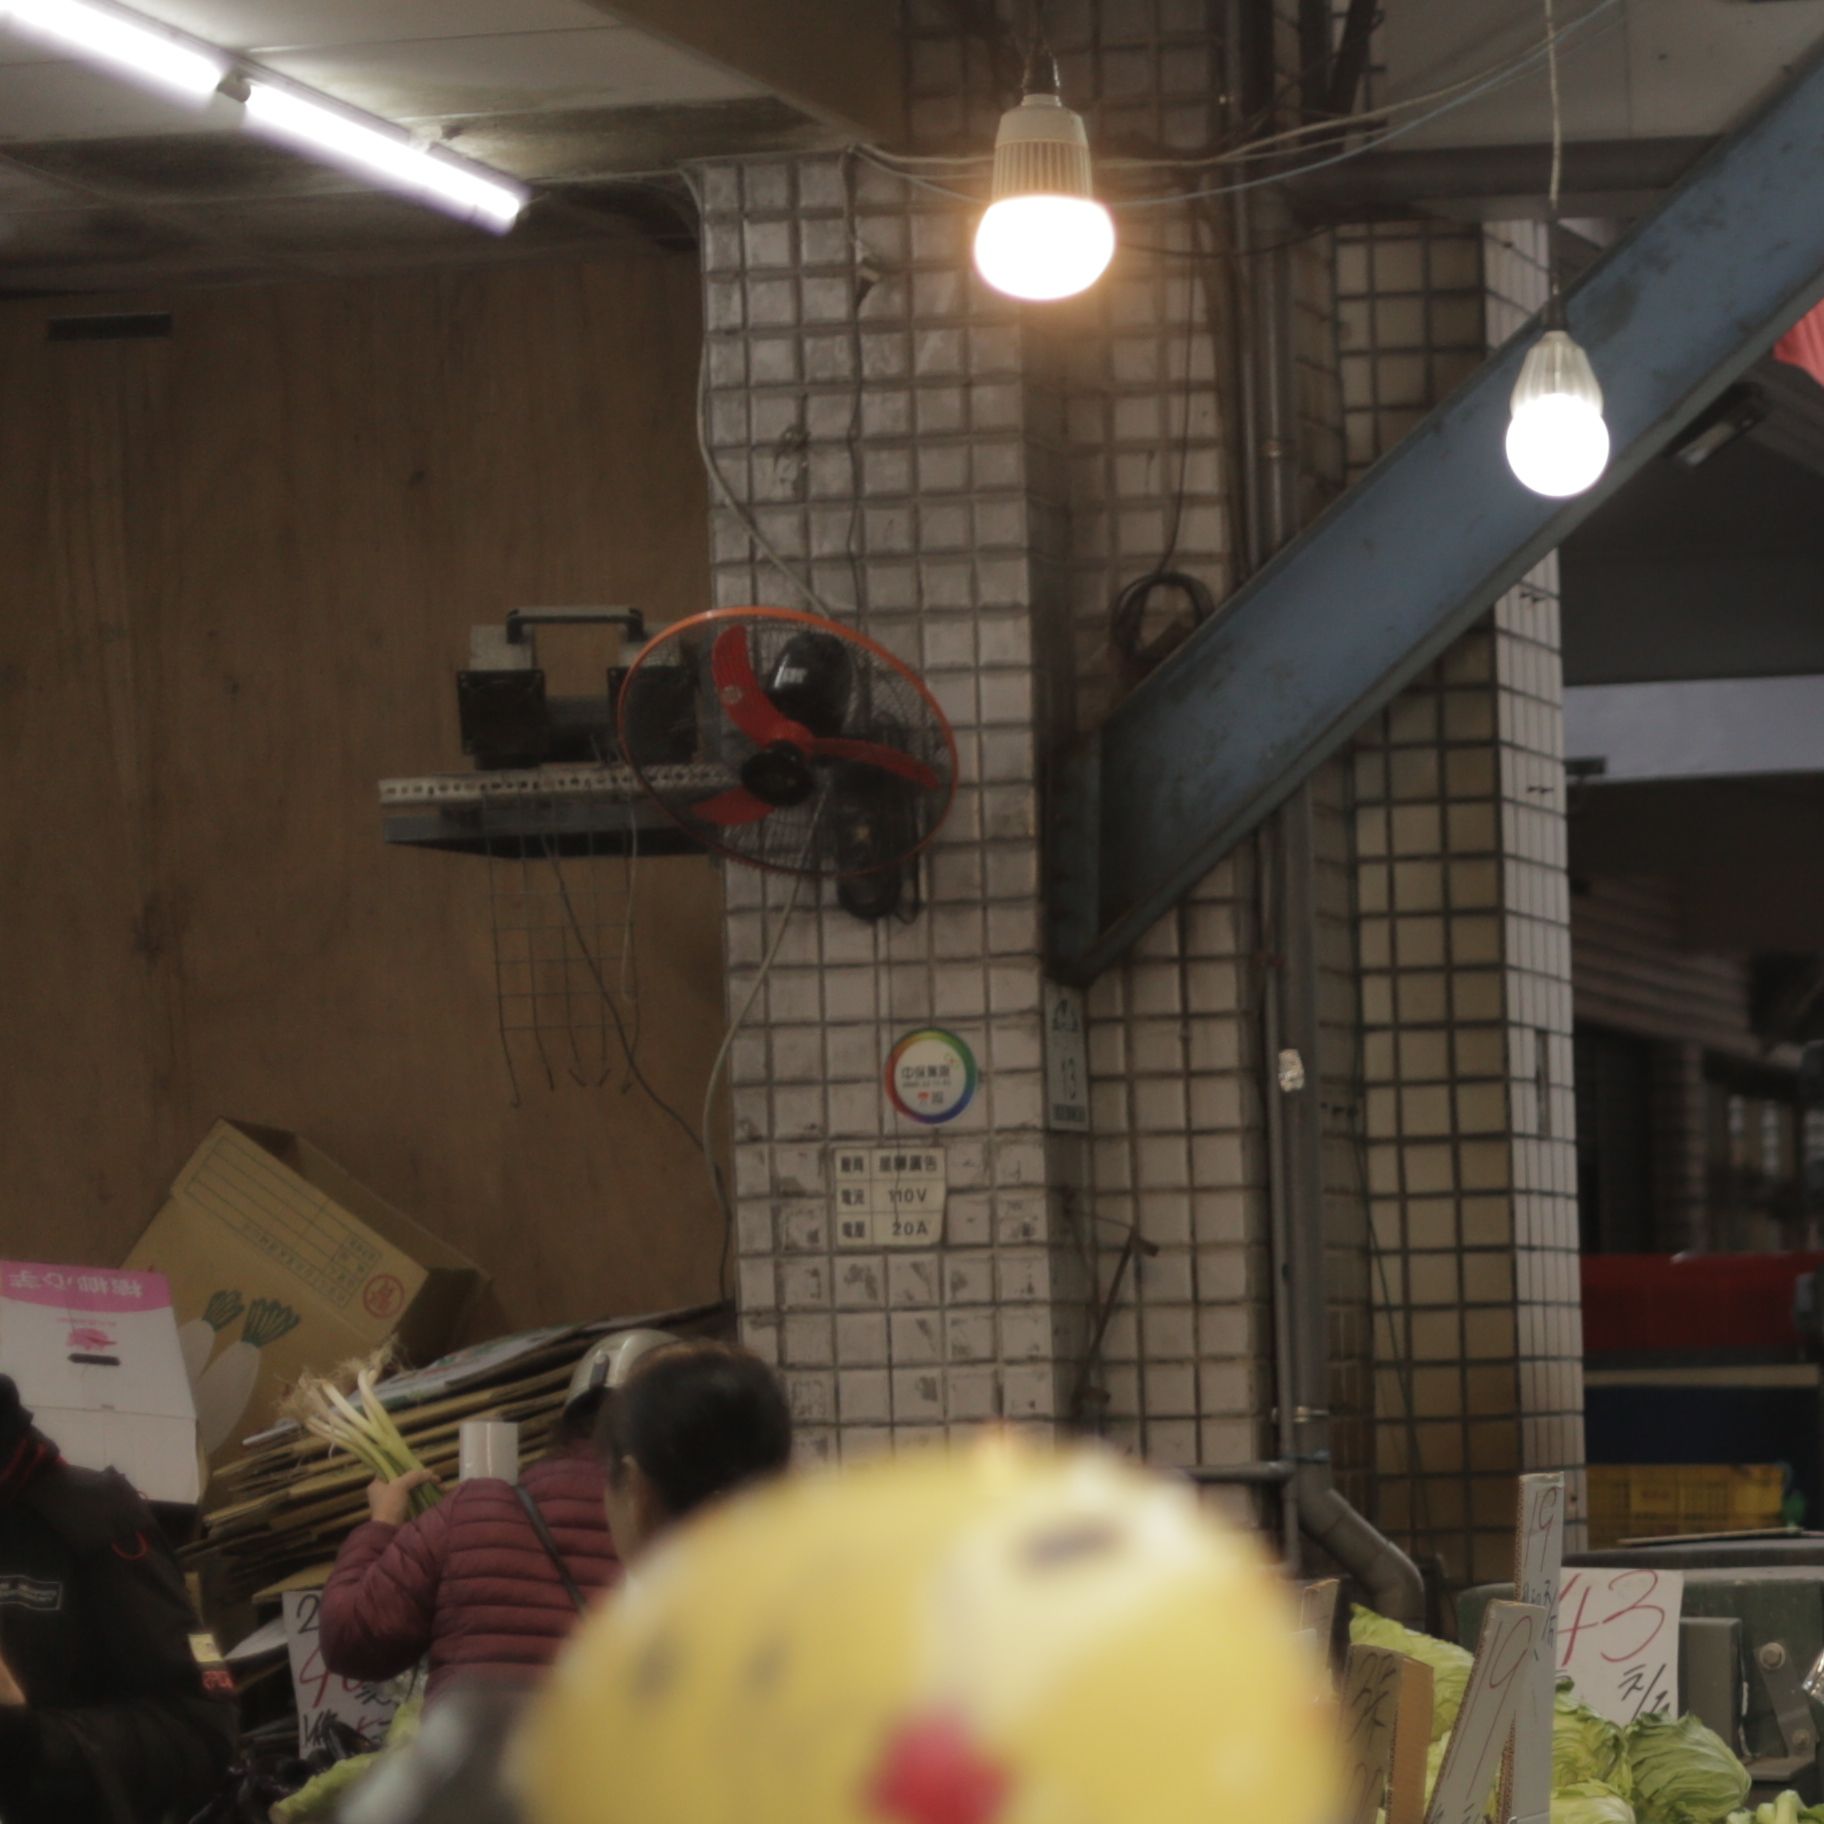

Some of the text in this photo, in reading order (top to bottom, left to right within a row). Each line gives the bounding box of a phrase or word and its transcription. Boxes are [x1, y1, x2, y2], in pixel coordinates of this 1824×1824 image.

[888, 1187, 927, 1203] 110V
[892, 1221, 928, 1236] 20A
[1557, 1569, 1666, 1667] 43
